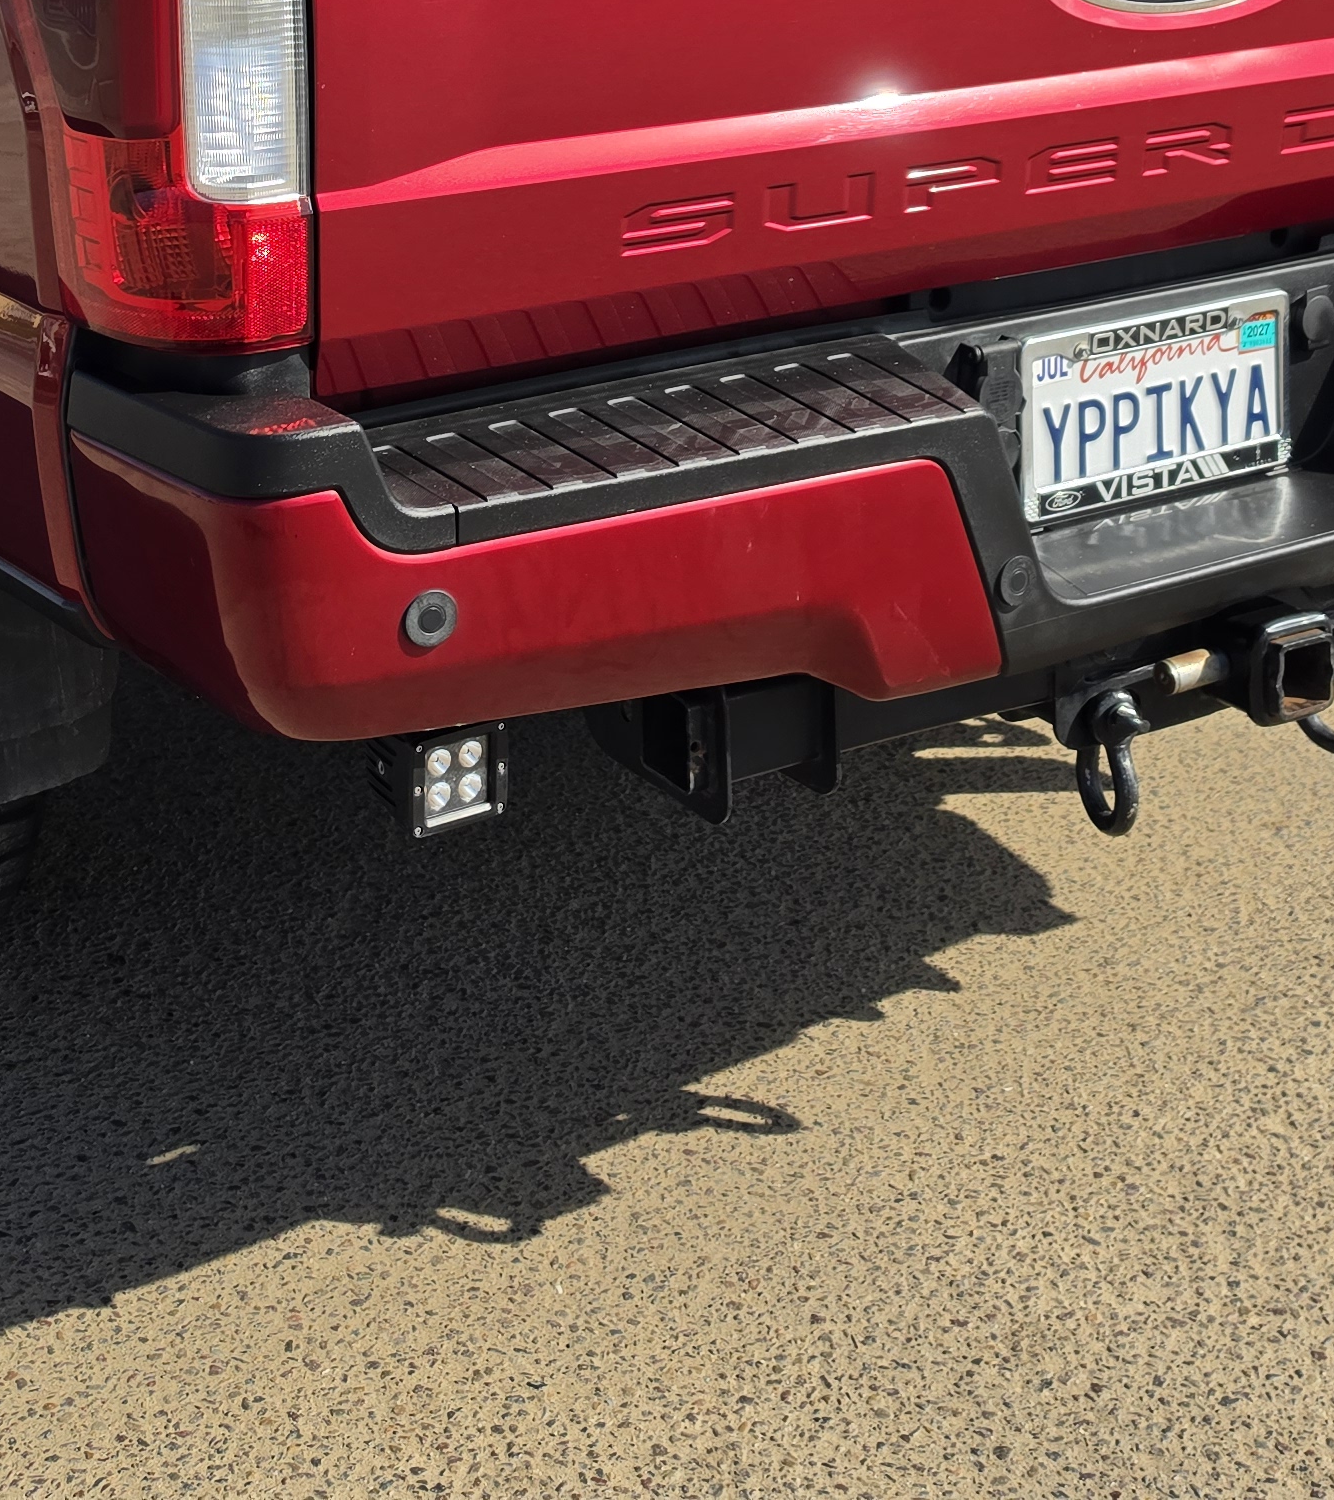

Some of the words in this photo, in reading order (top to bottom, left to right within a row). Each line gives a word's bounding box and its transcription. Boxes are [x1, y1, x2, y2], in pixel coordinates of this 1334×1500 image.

[620, 120, 1233, 258] SUPER
[1092, 310, 1227, 353] OXNARD
[1246, 322, 1271, 338] 2027
[1036, 355, 1069, 382] JUL
[1042, 364, 1271, 483] YPPIKYA
[1096, 459, 1203, 501] VISTA
